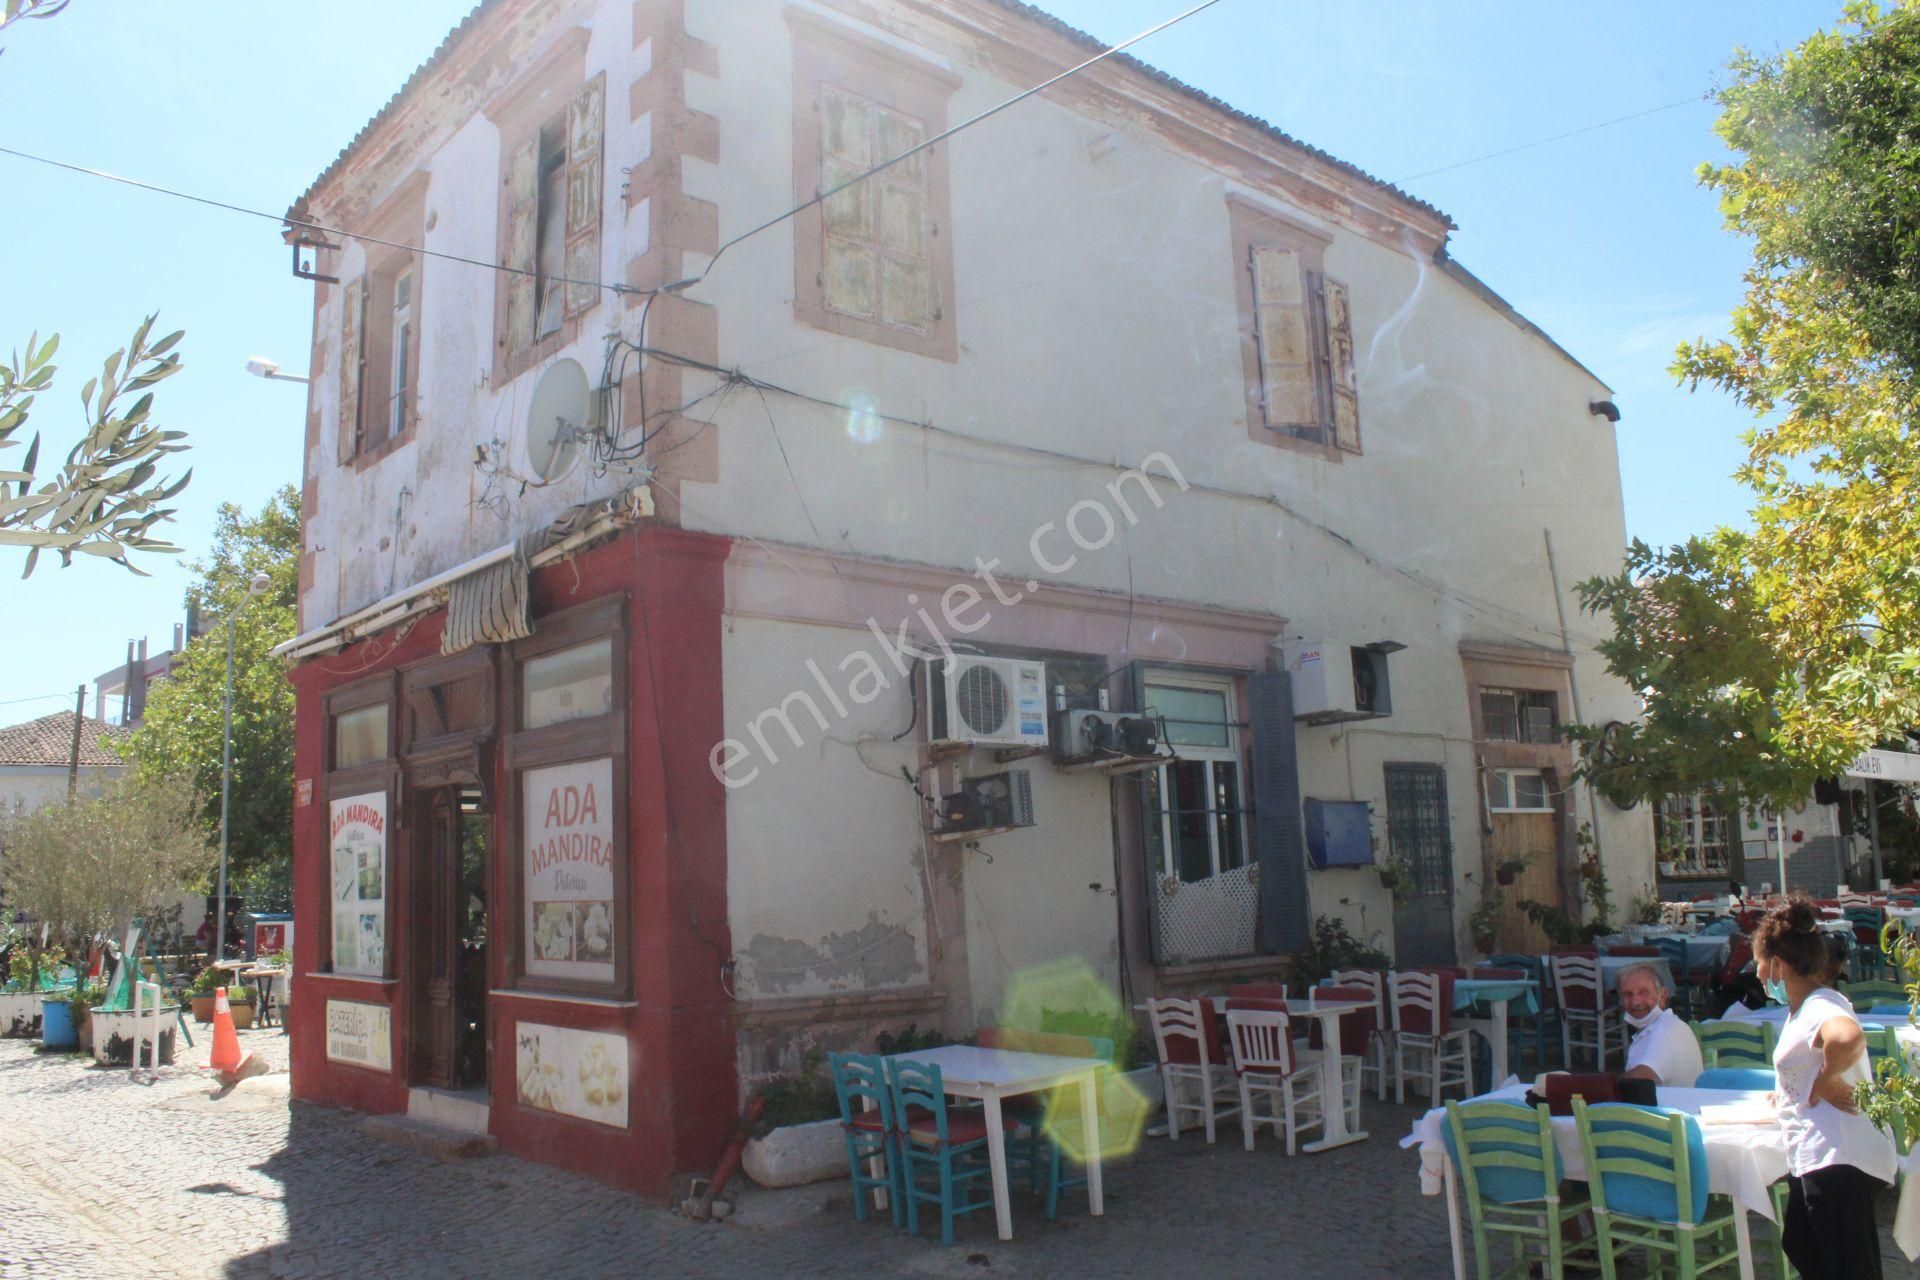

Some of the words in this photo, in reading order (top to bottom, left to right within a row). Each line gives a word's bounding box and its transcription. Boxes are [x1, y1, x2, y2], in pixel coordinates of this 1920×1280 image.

[333, 809, 346, 839] ADA
[347, 804, 384, 835] MANDIRA
[544, 783, 597, 828] ADA
[531, 833, 613, 876] MANDIRA
